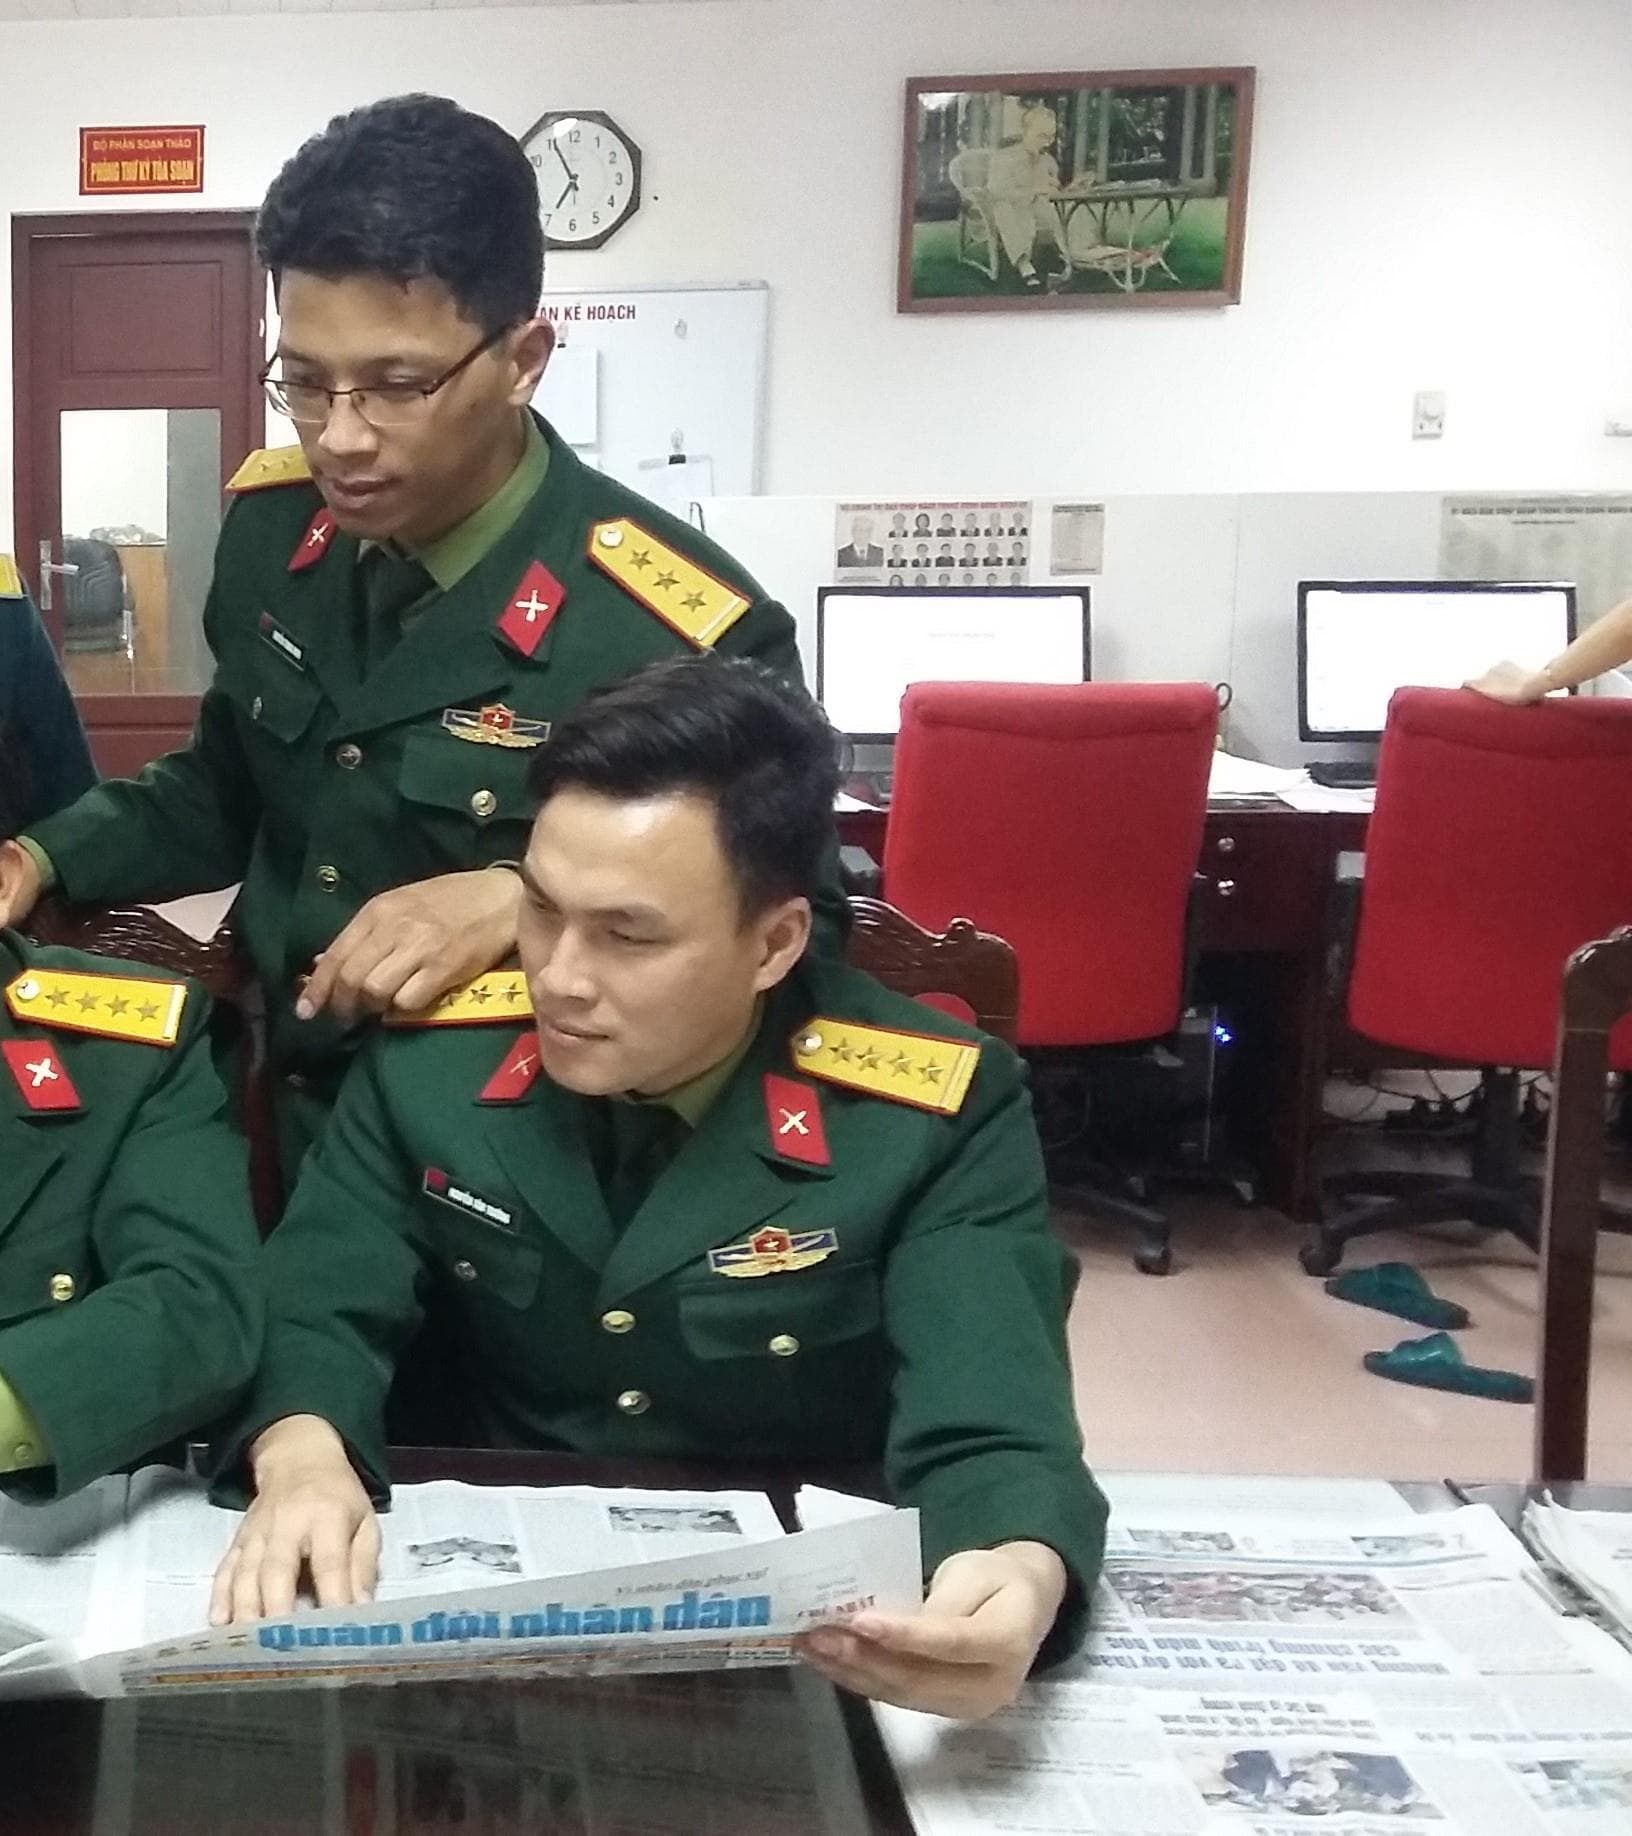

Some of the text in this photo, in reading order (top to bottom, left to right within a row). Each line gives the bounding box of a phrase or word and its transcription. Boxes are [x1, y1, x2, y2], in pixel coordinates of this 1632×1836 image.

[568, 130, 581, 143] 12
[594, 136, 600, 148] 1
[609, 151, 617, 164] 2
[615, 172, 623, 185] 3
[608, 195, 615, 207] 4
[544, 213, 552, 225] 7
[592, 211, 600, 224] 5
[569, 218, 577, 231] 6
[587, 304, 636, 323] HOẠCH
[258, 1622, 402, 1652] Quân
[411, 1609, 500, 1643] đội
[509, 1602, 655, 1639] nhân
[662, 1590, 772, 1632] dân
